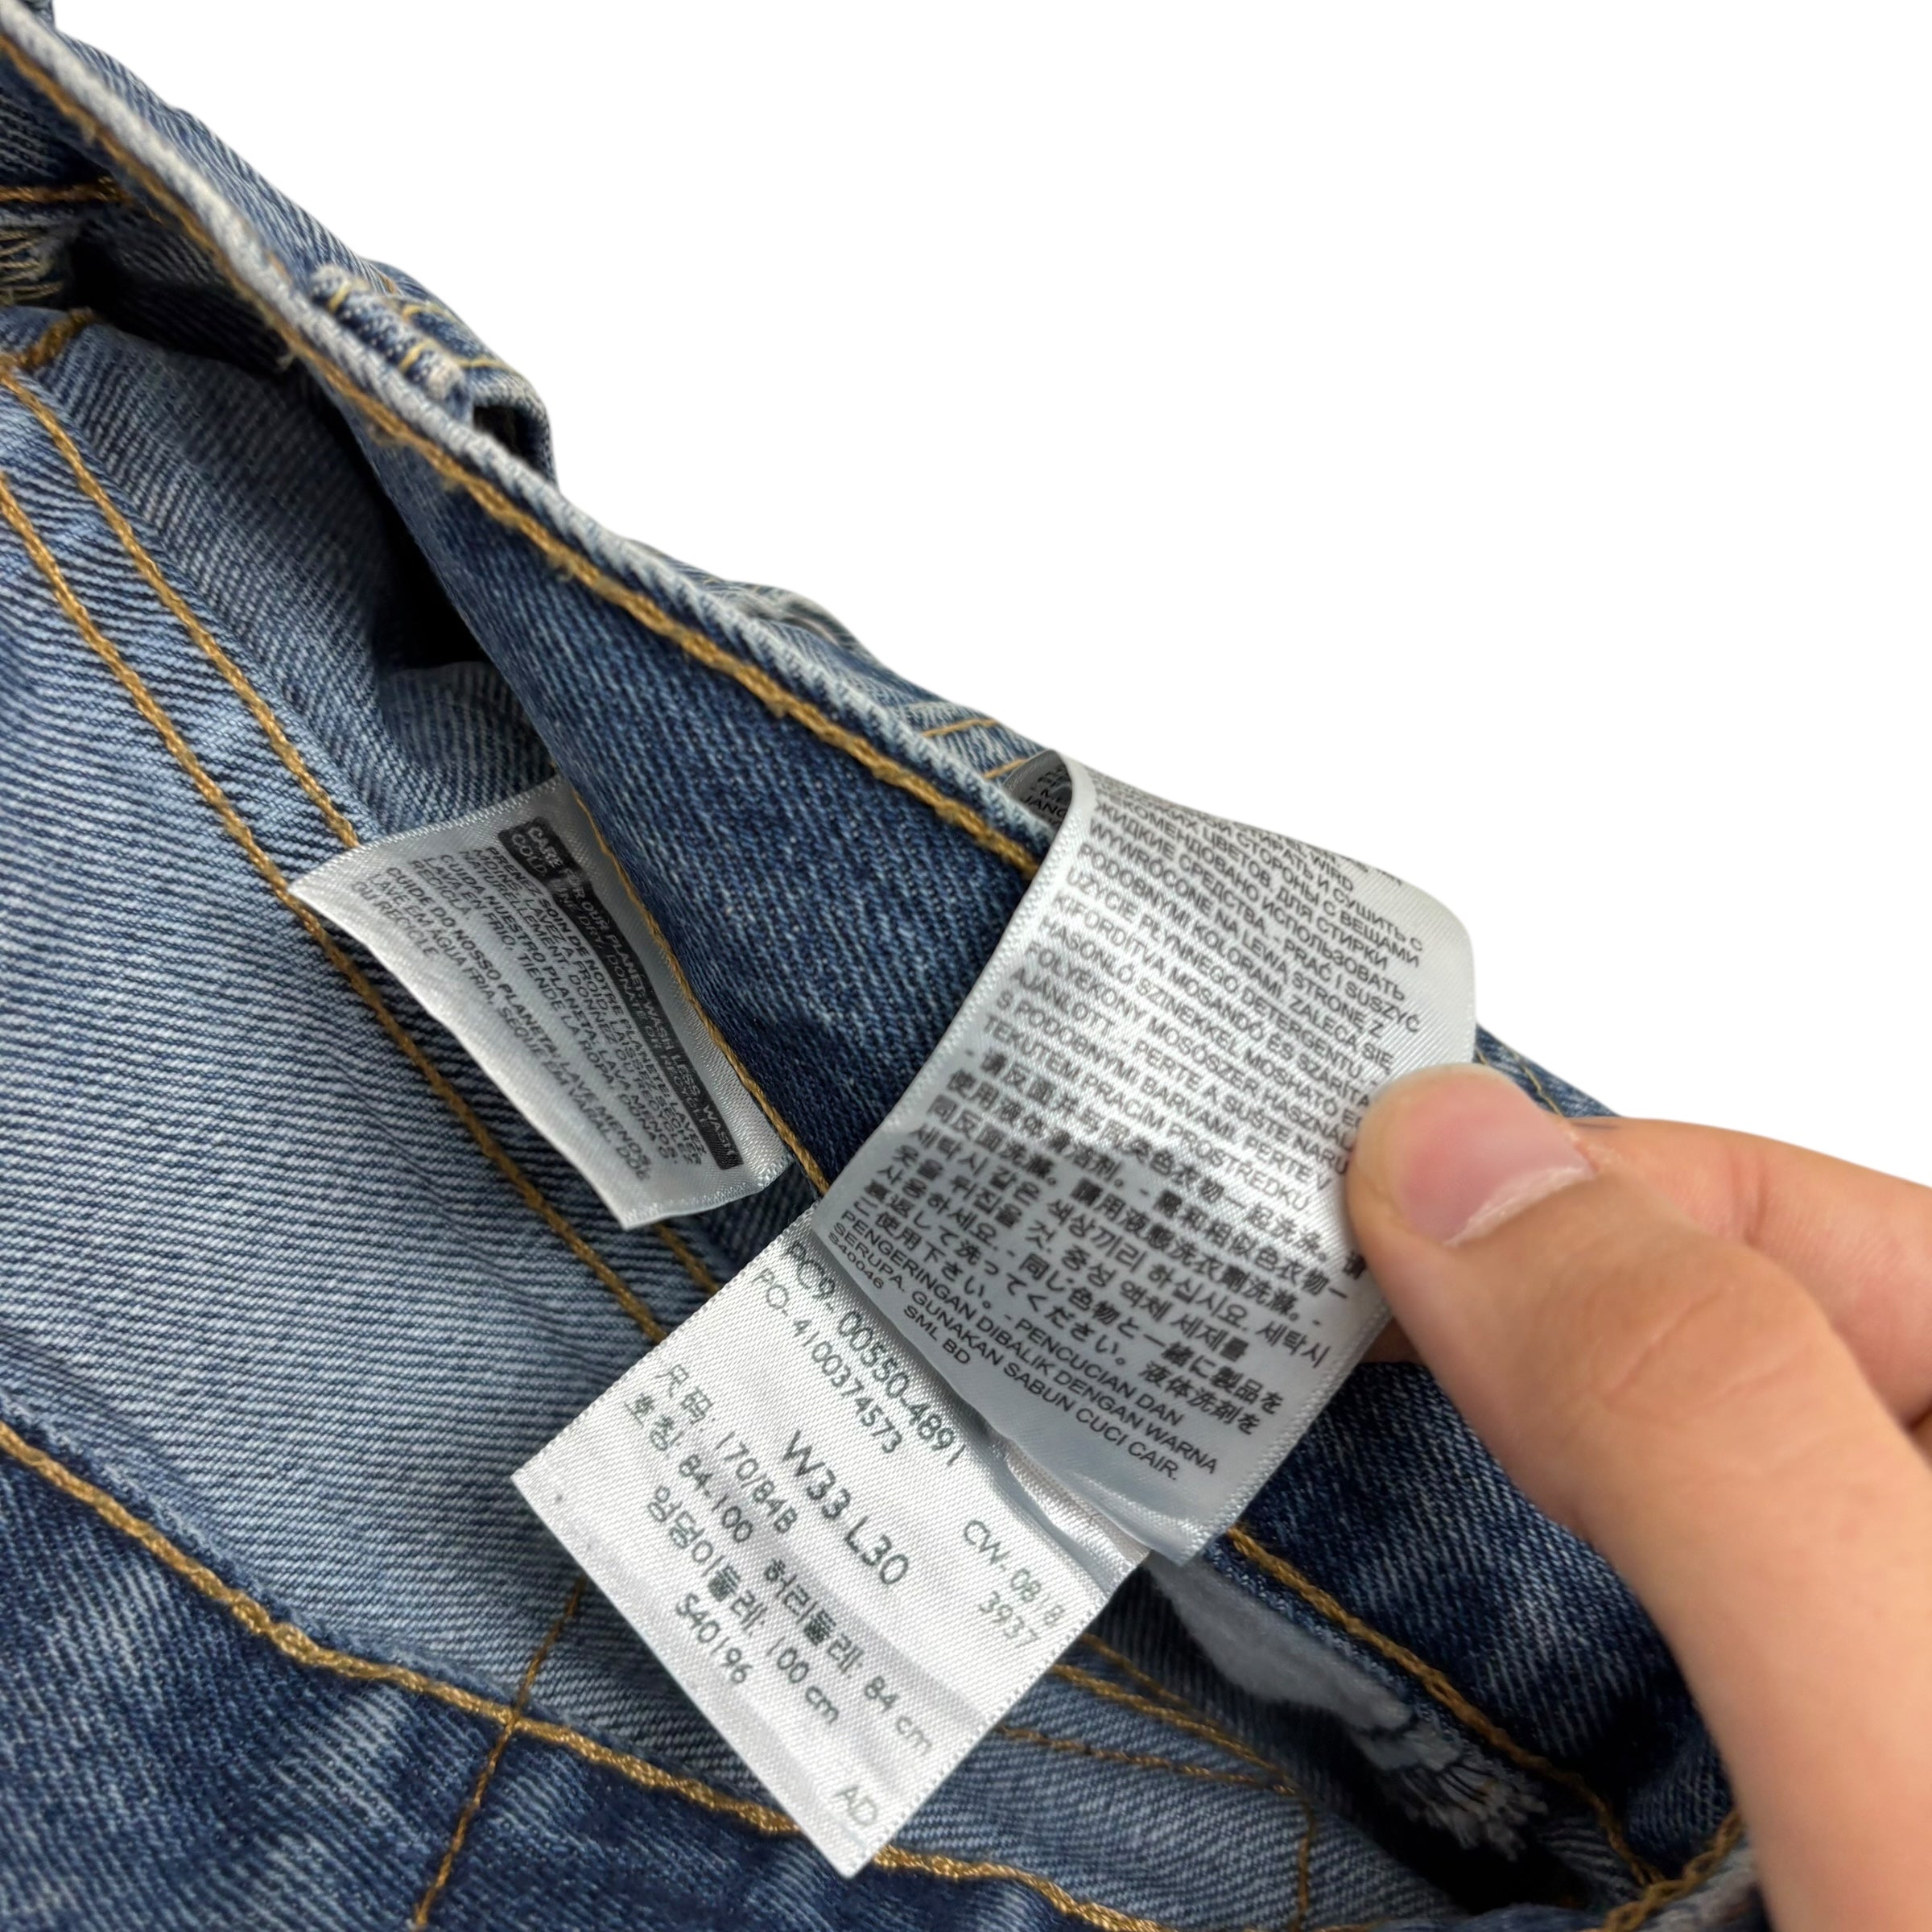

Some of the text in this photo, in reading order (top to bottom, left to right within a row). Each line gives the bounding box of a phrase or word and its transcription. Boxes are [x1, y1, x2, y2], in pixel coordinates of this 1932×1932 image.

[385, 866, 436, 906] CUIDE
[428, 906, 458, 928] DO
[451, 929, 504, 980] NOSSO
[423, 856, 464, 890] LAVA
[460, 890, 487, 910] EN
[514, 952, 567, 1011] TIENDE
[559, 1014, 582, 1035] LA
[485, 845, 543, 897] PRENEZ
[537, 898, 572, 933] SOIN
[567, 935, 590, 957] DE
[522, 897, 567, 943] LAVEZ
[1075, 841, 1192, 929] PODOBNYMI
[1287, 995, 1358, 1049] ZALECA
[1084, 817, 1216, 916] WYWRÓCONE
[1212, 910, 1245, 940] NA
[1239, 931, 1294, 983] LEWĄ
[1366, 1020, 1387, 1040] Z
[1094, 800, 1178, 861] ЖИДКИЕ
[1280, 939, 1335, 982] PRAĆ
[1343, 984, 1423, 1034] SUSZYĆ
[1234, 830, 1324, 906] СТОРОНЫ
[1319, 898, 1340, 917] С
[1337, 909, 1422, 968] ВЕЩАМИ
[1261, 898, 1407, 1002] ИСПОЛЬЗОВАТЬ
[1274, 888, 1317, 923] ДЛЯ
[1312, 914, 1391, 971] СТИРКИ
[1315, 875, 1331, 892] И
[1330, 887, 1408, 943] СУШИТЬ
[1407, 935, 1425, 952] С
[438, 852, 487, 894] CUIDA
[483, 895, 547, 964] NUESTRO
[598, 1050, 633, 1090] LAVA
[1036, 915, 1138, 986] HASONLÓ
[1241, 1048, 1342, 1118] MOSHATÓ
[1166, 965, 1267, 1043] MOSANDÓ
[1264, 1033, 1297, 1062] ÉS
[1130, 1038, 1204, 1092] PERTE
[1201, 1084, 1224, 1104] A
[907, 1118, 989, 1178] 세탁시
[1254, 1316, 1331, 1369] 세탁시
[1059, 1241, 1117, 1290] 중성
[786, 1313, 908, 1456] 4100374573
[831, 1220, 1183, 1482] SERUPA. GUNAKAN SABUN CUCI CAIR.
[831, 1308, 971, 1469] 00550-4891
[840, 1209, 1220, 1476] PENGERINGAN DIBALIK DENGAN WARNA
[902, 1303, 943, 1342] SML
[940, 1336, 972, 1367] BD
[1013, 1316, 1138, 1402] PENCUCIAN
[1133, 1390, 1185, 1429] DAN
[770, 1429, 916, 1590] W33 L30
[669, 1591, 759, 1687] S40196
[673, 1455, 758, 1546] 84-100
[860, 1675, 900, 1715] 84
[890, 1711, 937, 1759] cm
[976, 1589, 1042, 1654] 3937
[762, 1636, 812, 1686] 100
[800, 1682, 844, 1726] cm
[834, 1781, 886, 1830] AD
